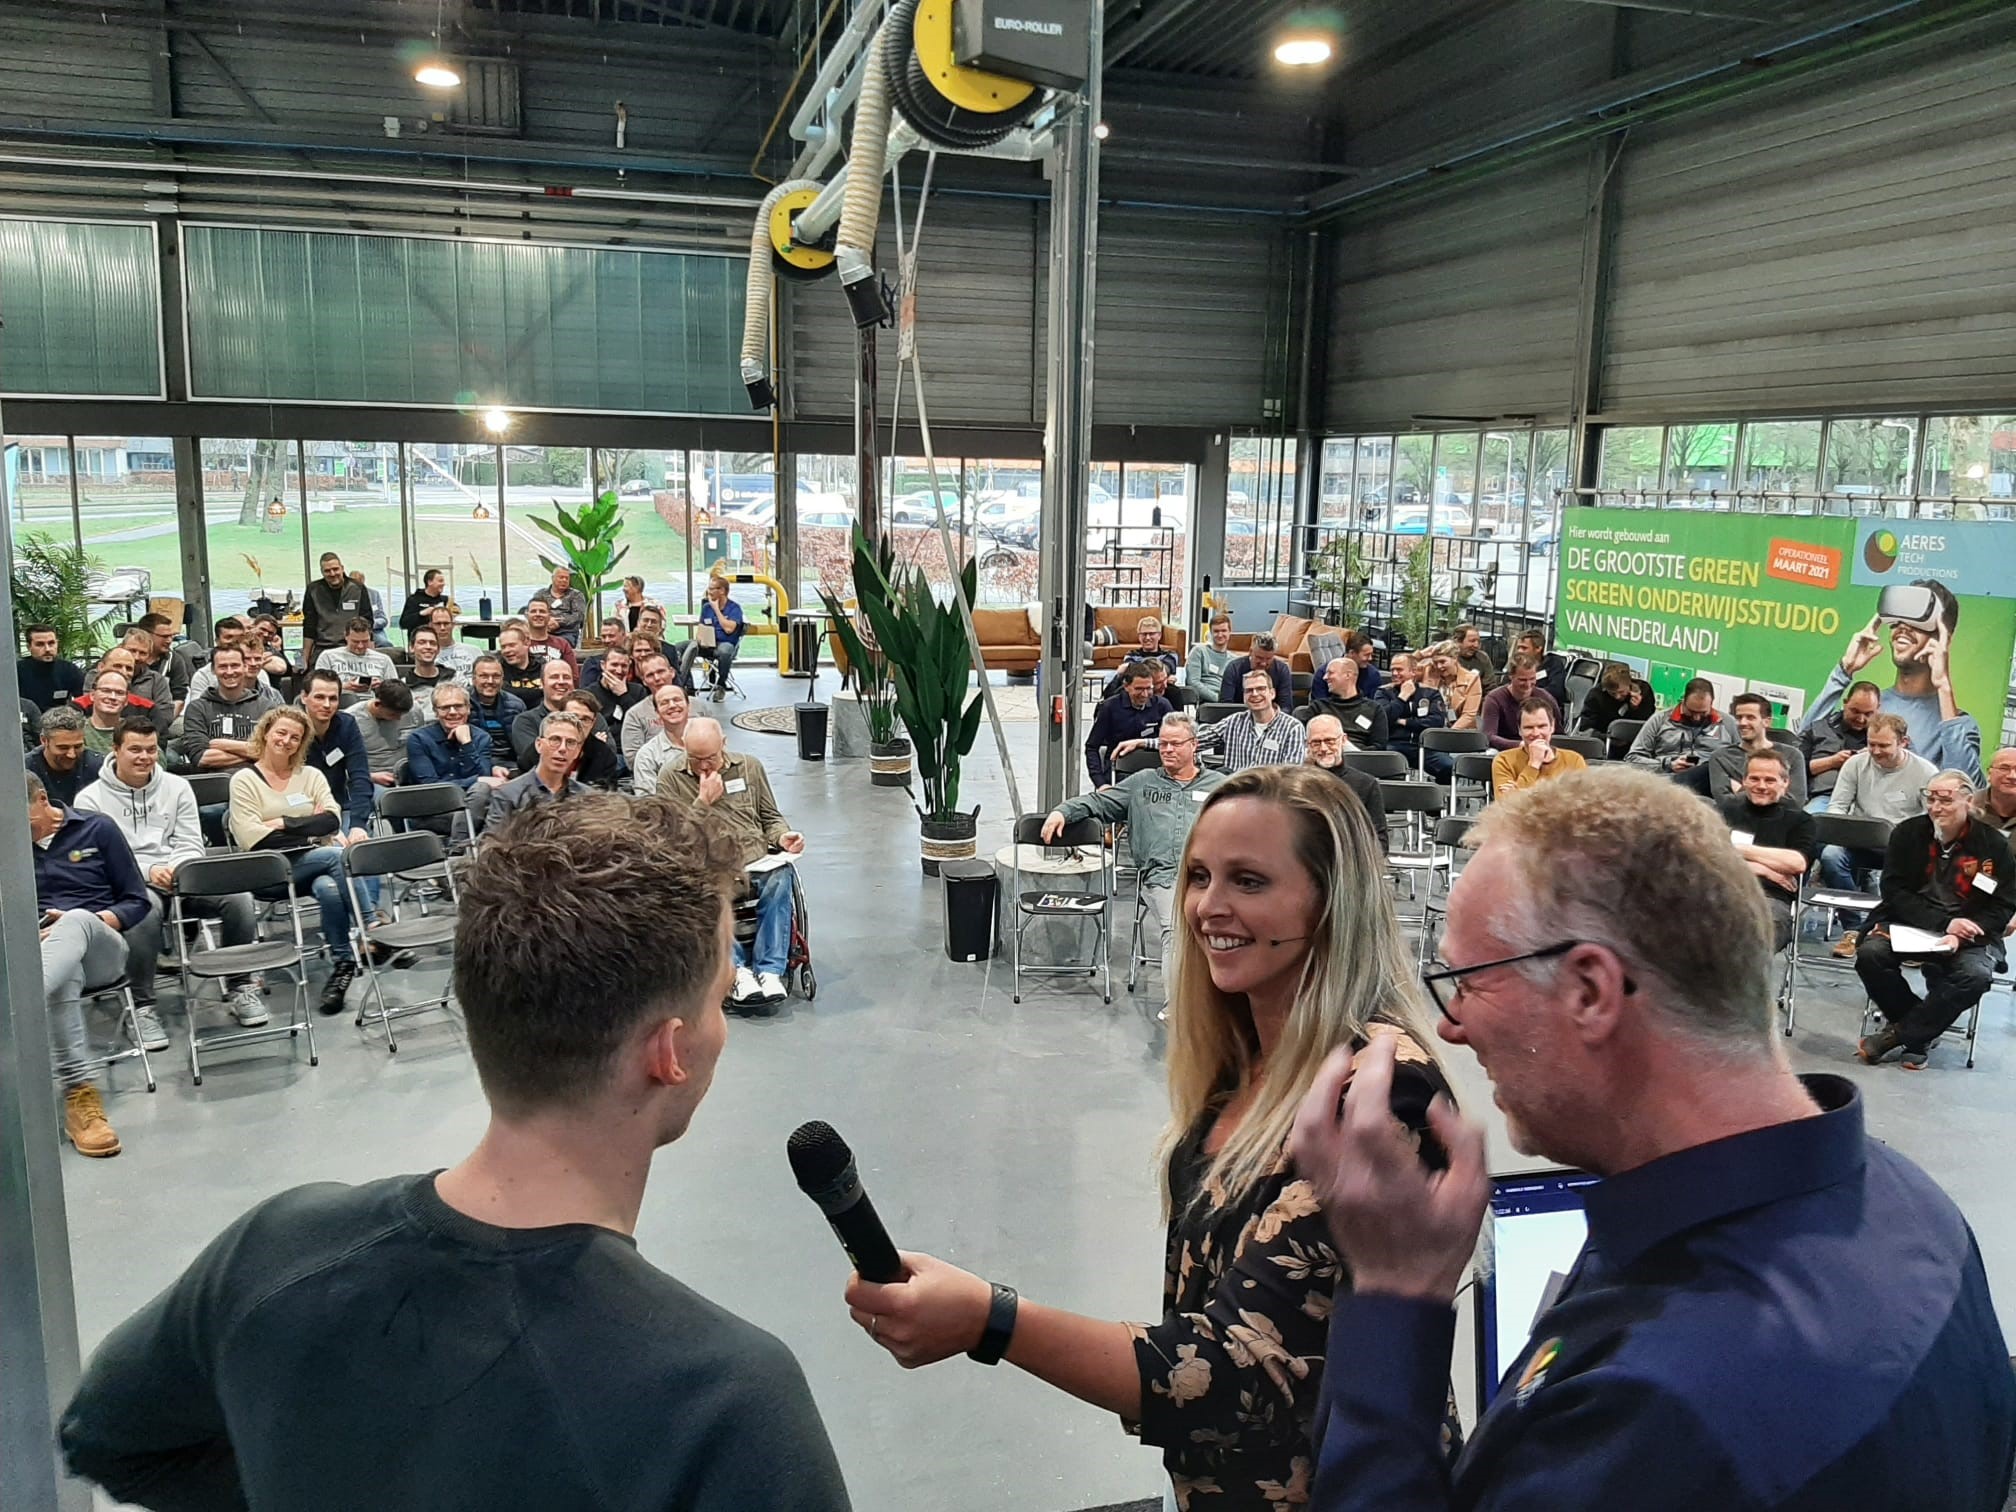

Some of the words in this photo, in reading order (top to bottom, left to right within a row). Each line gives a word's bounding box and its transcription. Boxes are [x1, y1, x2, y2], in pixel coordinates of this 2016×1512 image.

[994, 17, 1063, 36] EURO-ROLLER
[1568, 525, 1587, 539] Hier
[1588, 527, 1613, 541] wordt
[1613, 528, 1653, 545] gebouwd
[1654, 533, 1670, 544] aan
[1900, 534, 1946, 551] AERES
[1778, 547, 1829, 565] OPERATIONEEL
[1898, 551, 1925, 563] TECH
[1567, 547, 1591, 571] DE
[1593, 549, 1686, 579] GROOTSTE
[1688, 556, 1760, 588] GREEN
[1773, 557, 1808, 577] MAART
[1808, 564, 1830, 579] 2021
[1897, 566, 1959, 579] PRODUCTIONS
[1566, 578, 1634, 608] SCREEN
[1637, 586, 1840, 635] ONDERWIJSSTUDIO
[1565, 609, 1602, 635] VAN
[1606, 614, 1720, 656] NEDERLAND!
